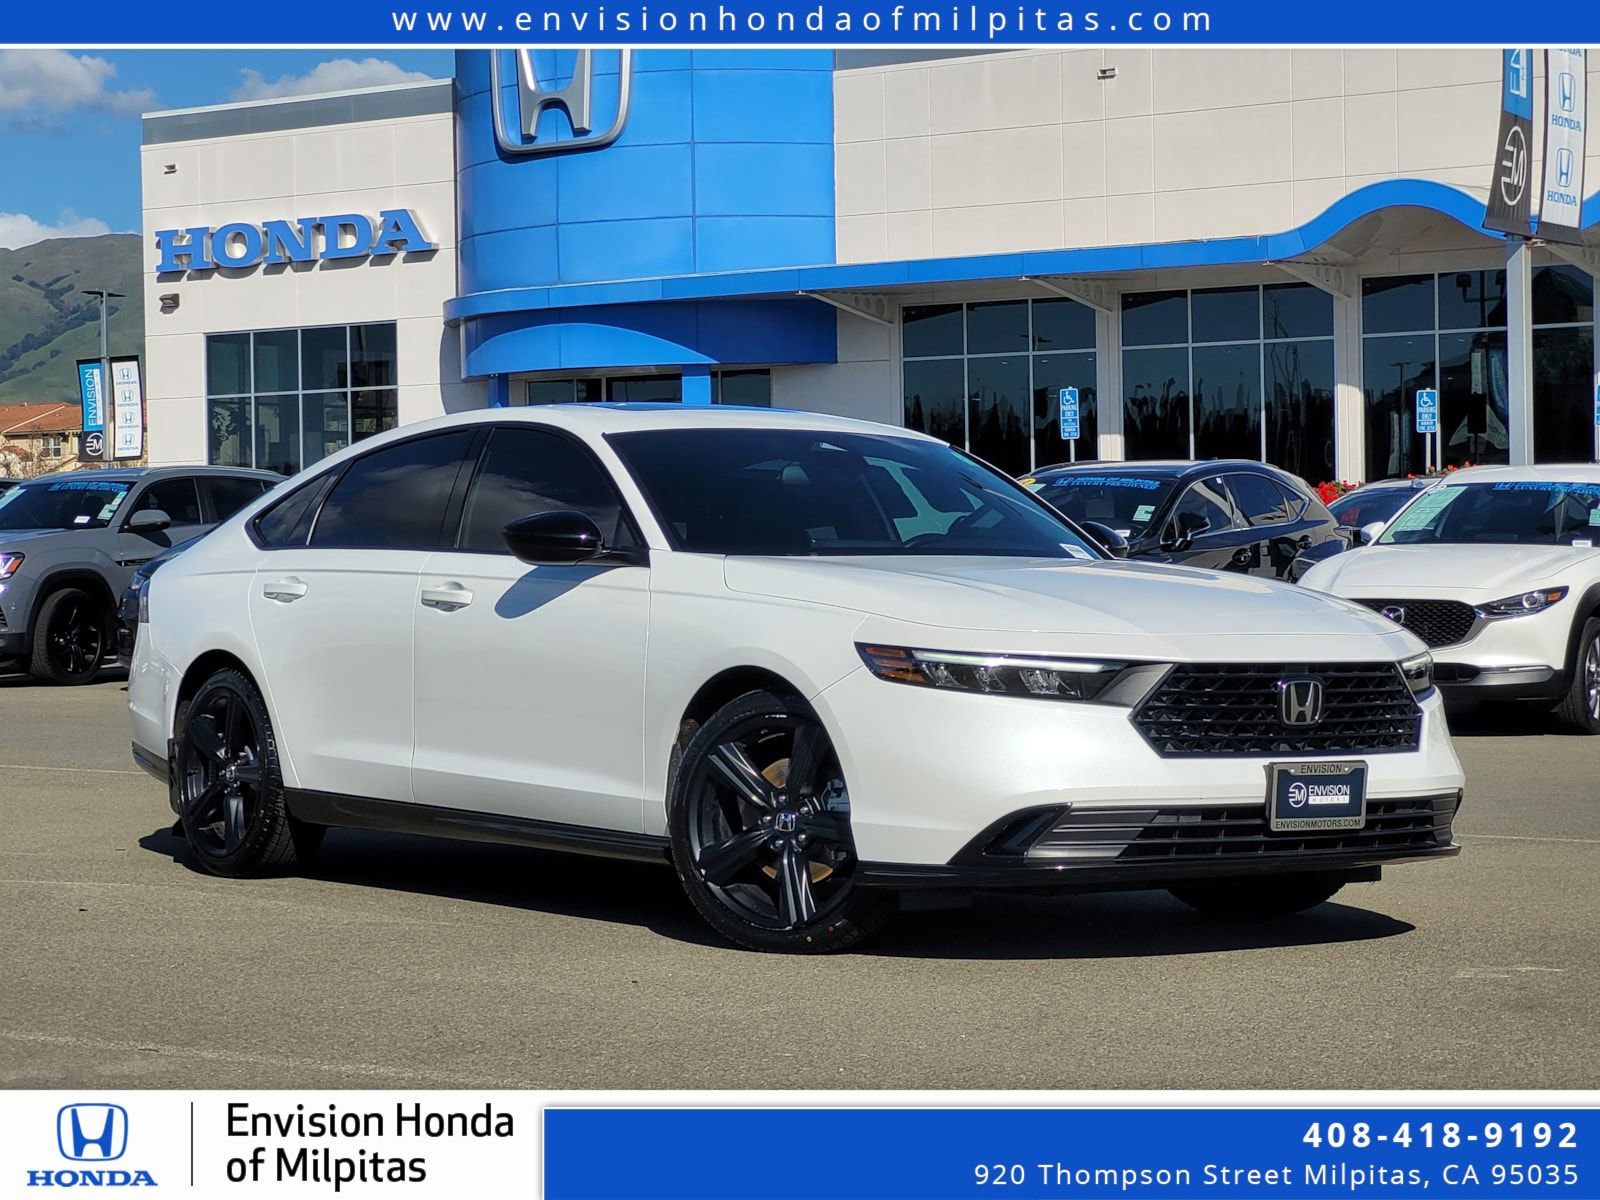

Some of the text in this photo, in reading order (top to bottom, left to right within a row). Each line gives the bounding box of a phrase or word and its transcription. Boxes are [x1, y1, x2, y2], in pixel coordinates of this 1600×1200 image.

[1552, 114, 1582, 132] HONDA
[1547, 190, 1577, 206] HONDA
[155, 208, 438, 273] HONDA
[85, 368, 97, 426] ENVISION
[1301, 764, 1342, 774] ENVISION
[1309, 784, 1350, 796] ENVISION
[1311, 796, 1347, 804] MOTORS
[1275, 818, 1361, 829] ENVISIONMOTORS.COM
